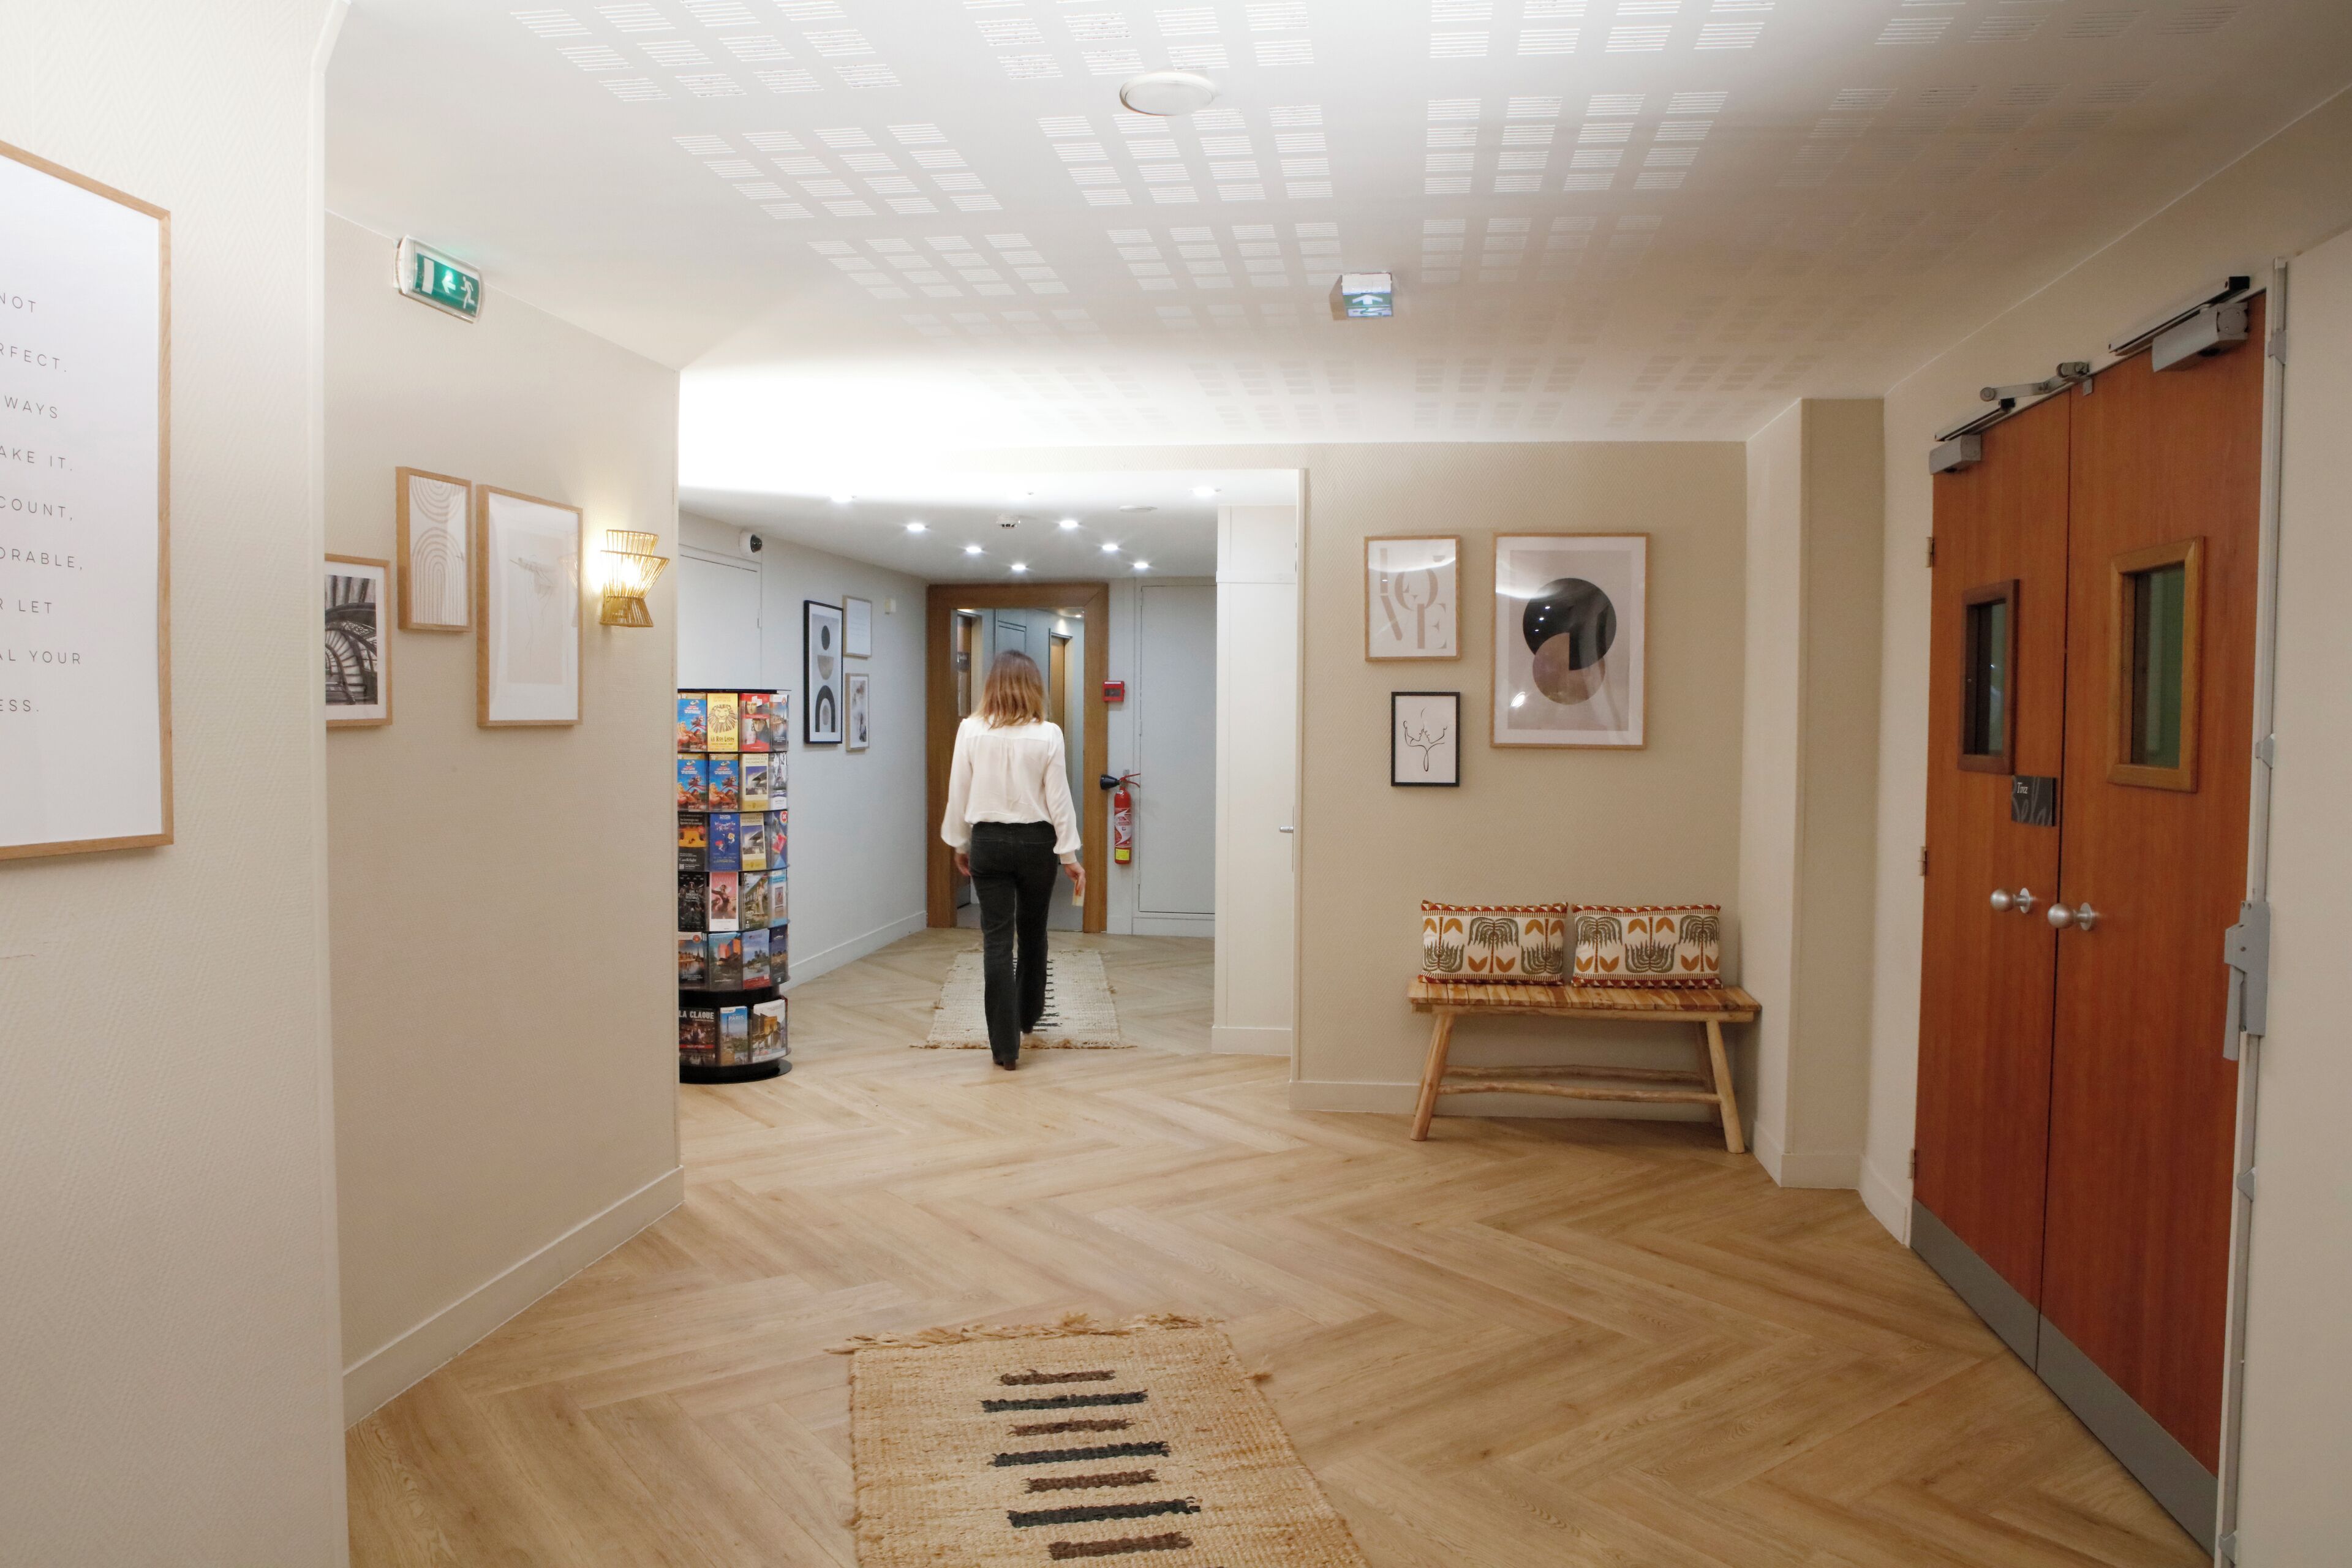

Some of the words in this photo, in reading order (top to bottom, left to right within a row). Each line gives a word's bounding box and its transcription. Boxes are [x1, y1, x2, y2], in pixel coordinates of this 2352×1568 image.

[0, 292, 36, 313] NOT
[4, 394, 58, 419] WAYS
[0, 445, 35, 464] AKE
[50, 455, 72, 471] IT.
[0, 496, 73, 521] COUNT,
[18, 599, 53, 614] LET
[0, 649, 17, 662] L
[29, 650, 81, 665] YOUR
